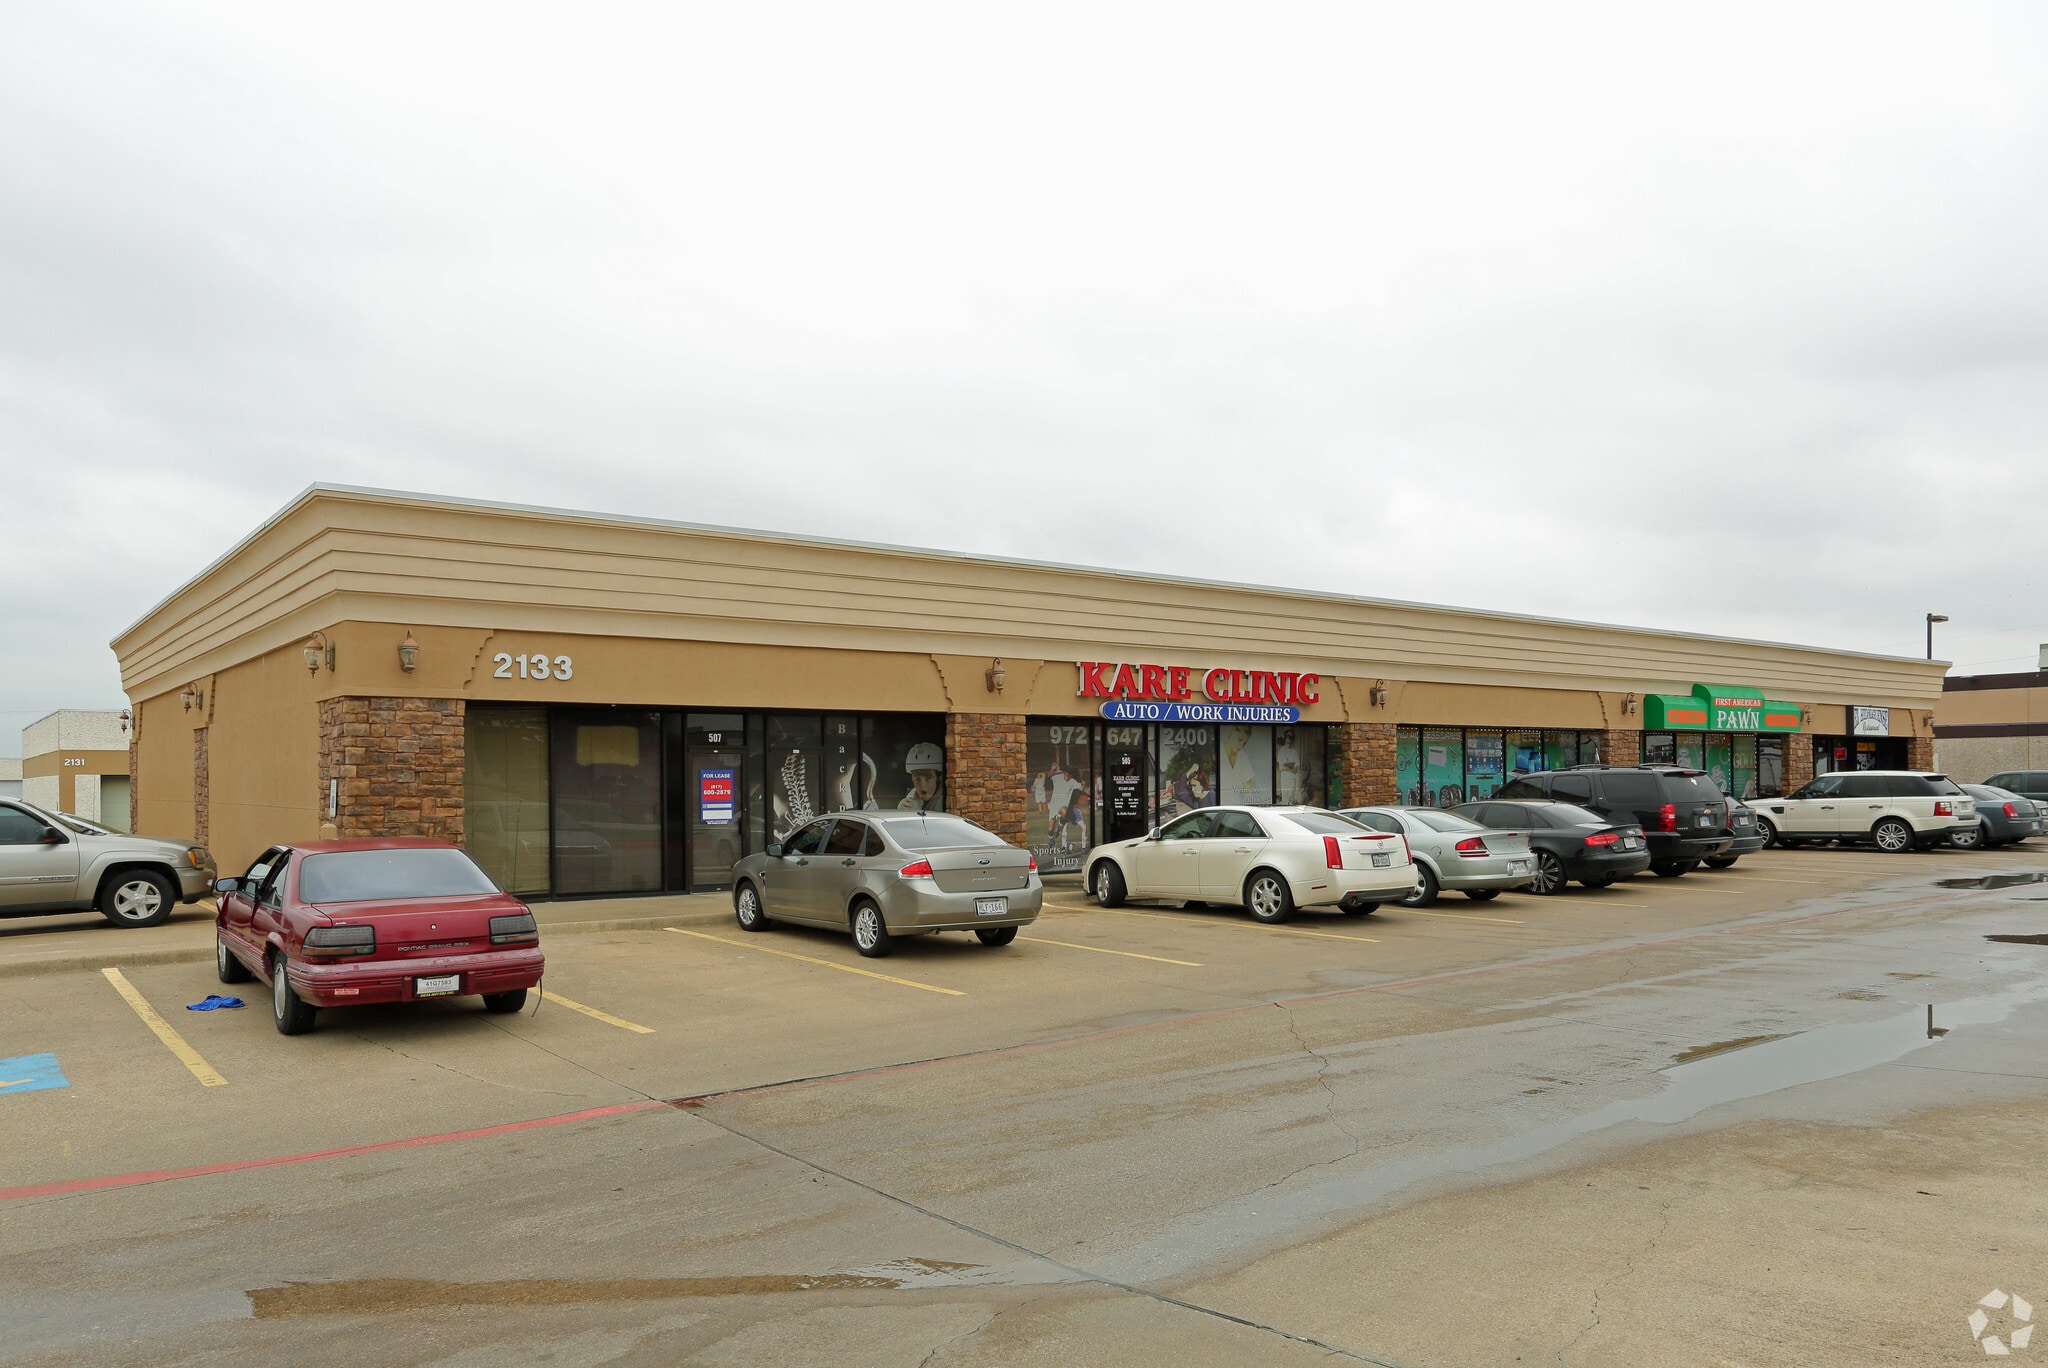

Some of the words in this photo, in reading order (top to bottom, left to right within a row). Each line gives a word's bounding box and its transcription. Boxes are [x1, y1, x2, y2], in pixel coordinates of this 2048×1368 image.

[493, 652, 573, 681] 2133
[1078, 661, 1191, 699] KARE
[1203, 668, 1319, 704] CLINIC
[1715, 698, 1732, 706] FIRST
[1732, 698, 1761, 707] AMERICAN
[1114, 703, 1159, 720] AUTO
[1176, 705, 1223, 720] WORK
[1227, 706, 1291, 721] INJURIES
[1717, 708, 1760, 729] PAWN
[708, 733, 722, 743] 507
[1049, 726, 1088, 745] 972
[1107, 727, 1142, 746] 647
[1164, 727, 1208, 746] 2400
[1397, 731, 1408, 739] ND
[64, 758, 85, 767] 2131
[1033, 845, 1061, 857] Sports
[1053, 856, 1080, 868] Injury
